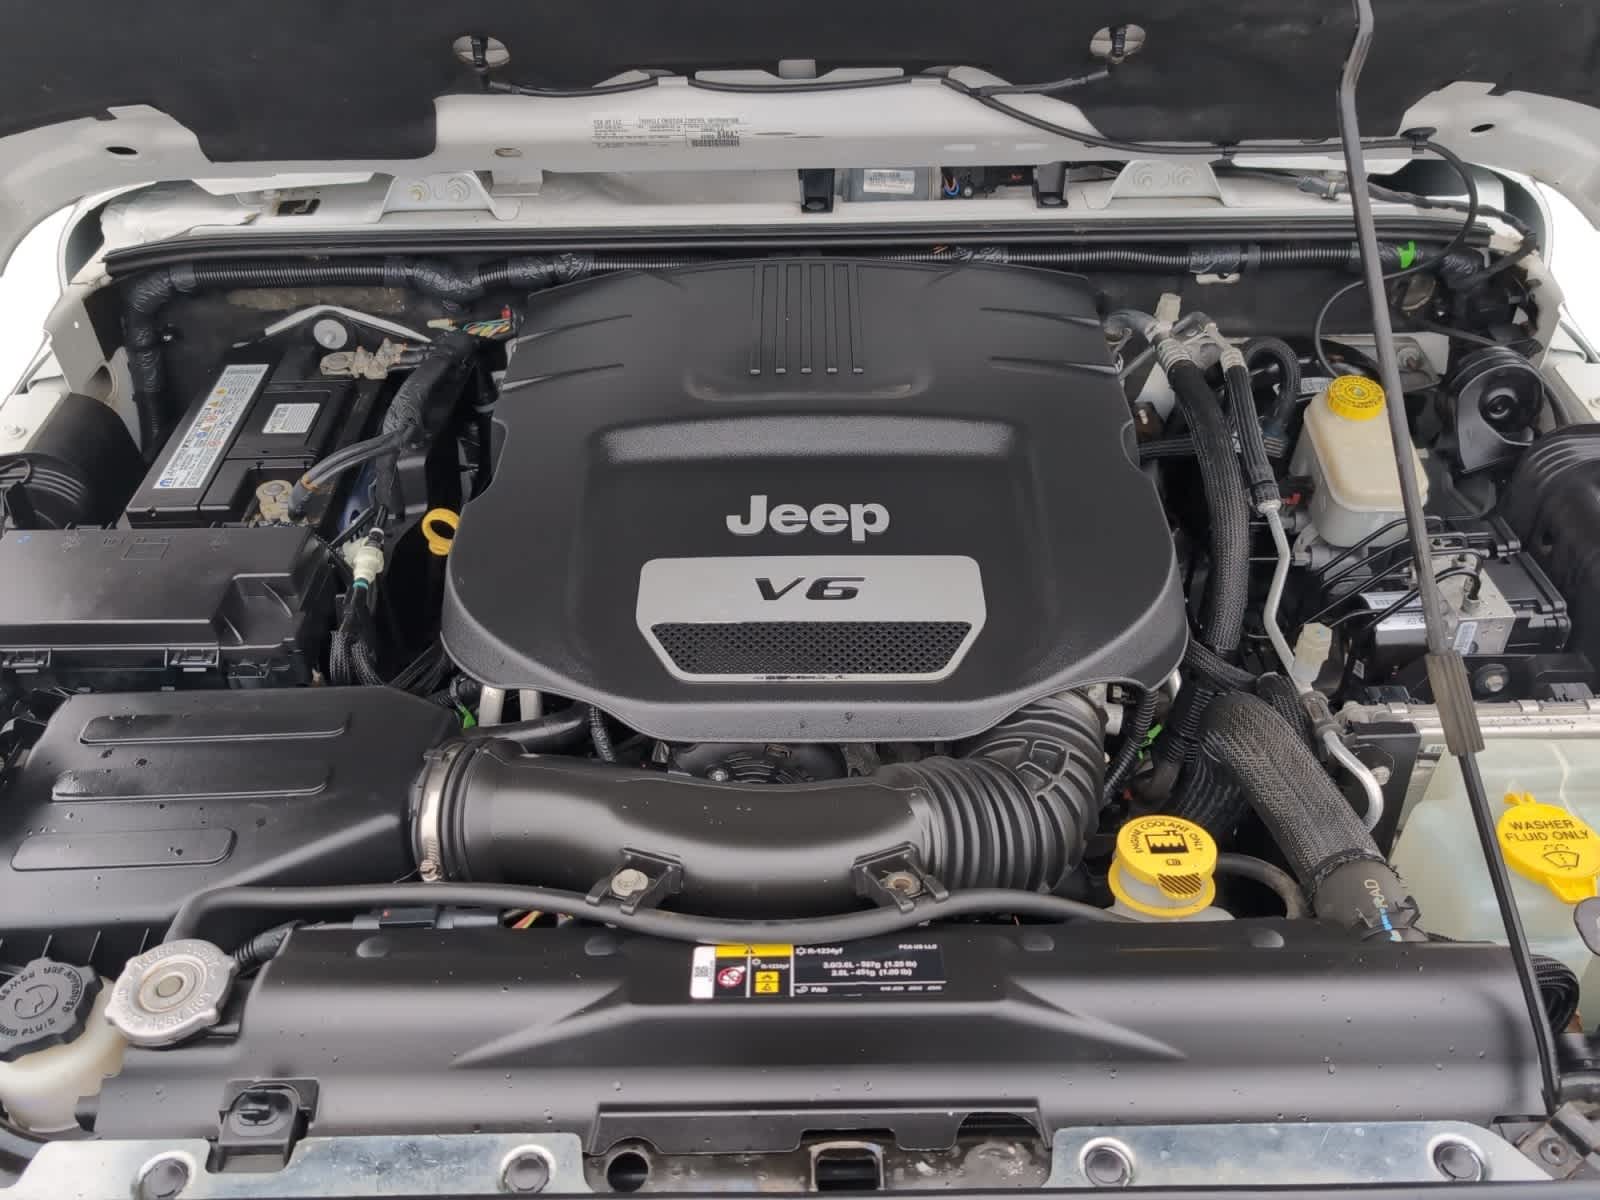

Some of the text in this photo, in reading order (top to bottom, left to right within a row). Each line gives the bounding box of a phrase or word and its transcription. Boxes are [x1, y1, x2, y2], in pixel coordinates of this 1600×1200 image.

[726, 495, 890, 542] Jeep
[755, 577, 866, 601] V6
[1140, 820, 1190, 833] COOLANT
[1510, 819, 1575, 831] WASHER
[1505, 829, 1590, 842] FLUID ONLY
